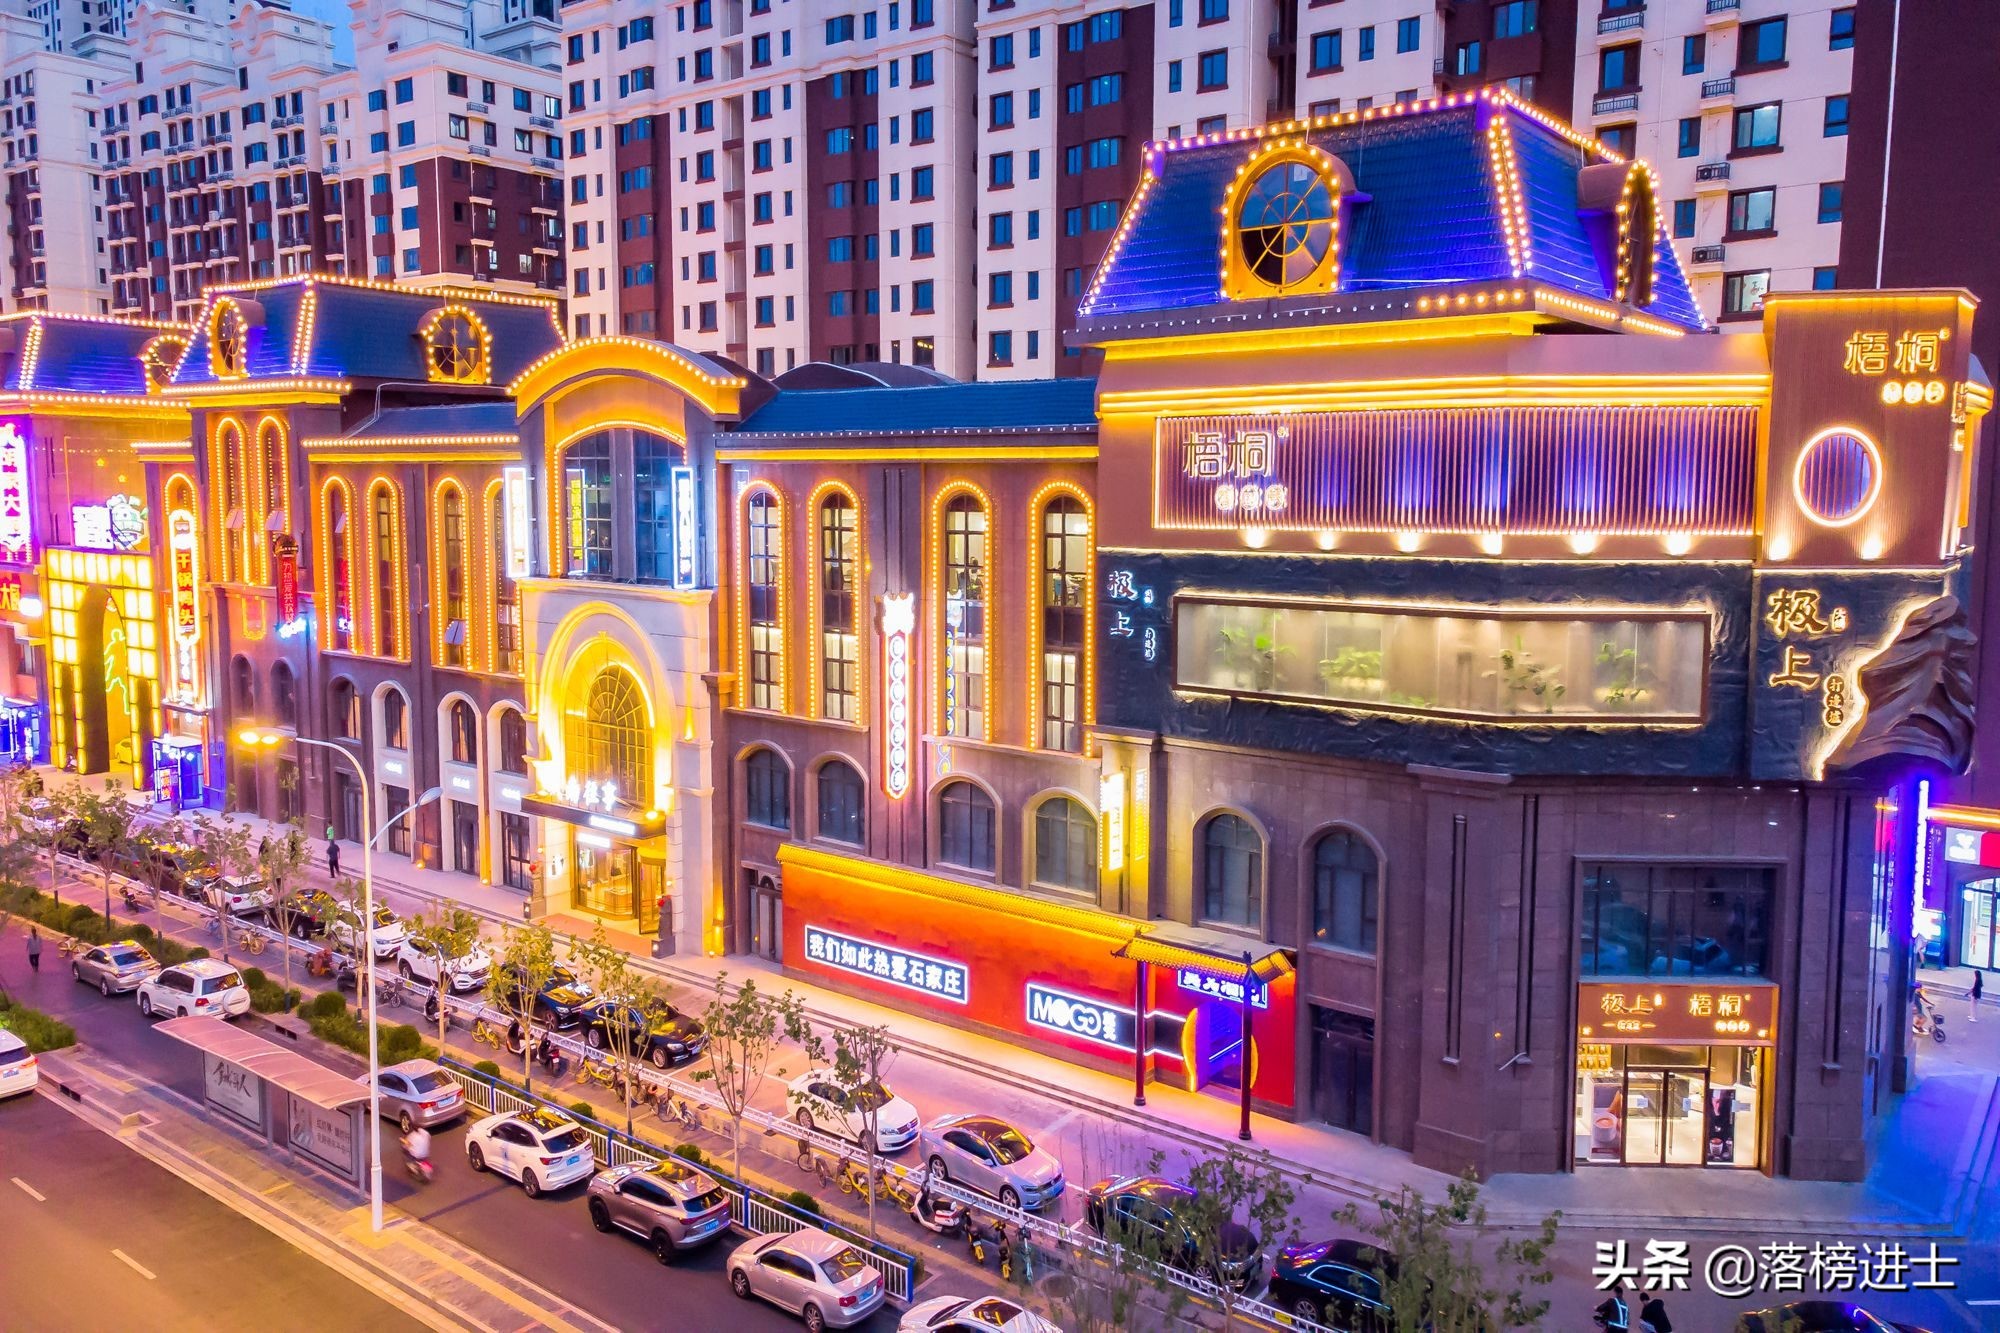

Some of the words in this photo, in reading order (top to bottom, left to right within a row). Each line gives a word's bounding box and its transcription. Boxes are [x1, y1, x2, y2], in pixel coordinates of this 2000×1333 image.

[1844, 330, 1939, 375] 梧桐
[1182, 431, 1272, 478] 梧桐
[1106, 571, 1139, 637] 极上
[1767, 589, 1829, 691] 极上
[809, 933, 963, 995] 我们如此热爱石家庄
[1601, 992, 1653, 1015] 极上
[1689, 993, 1742, 1016] 梧桐
